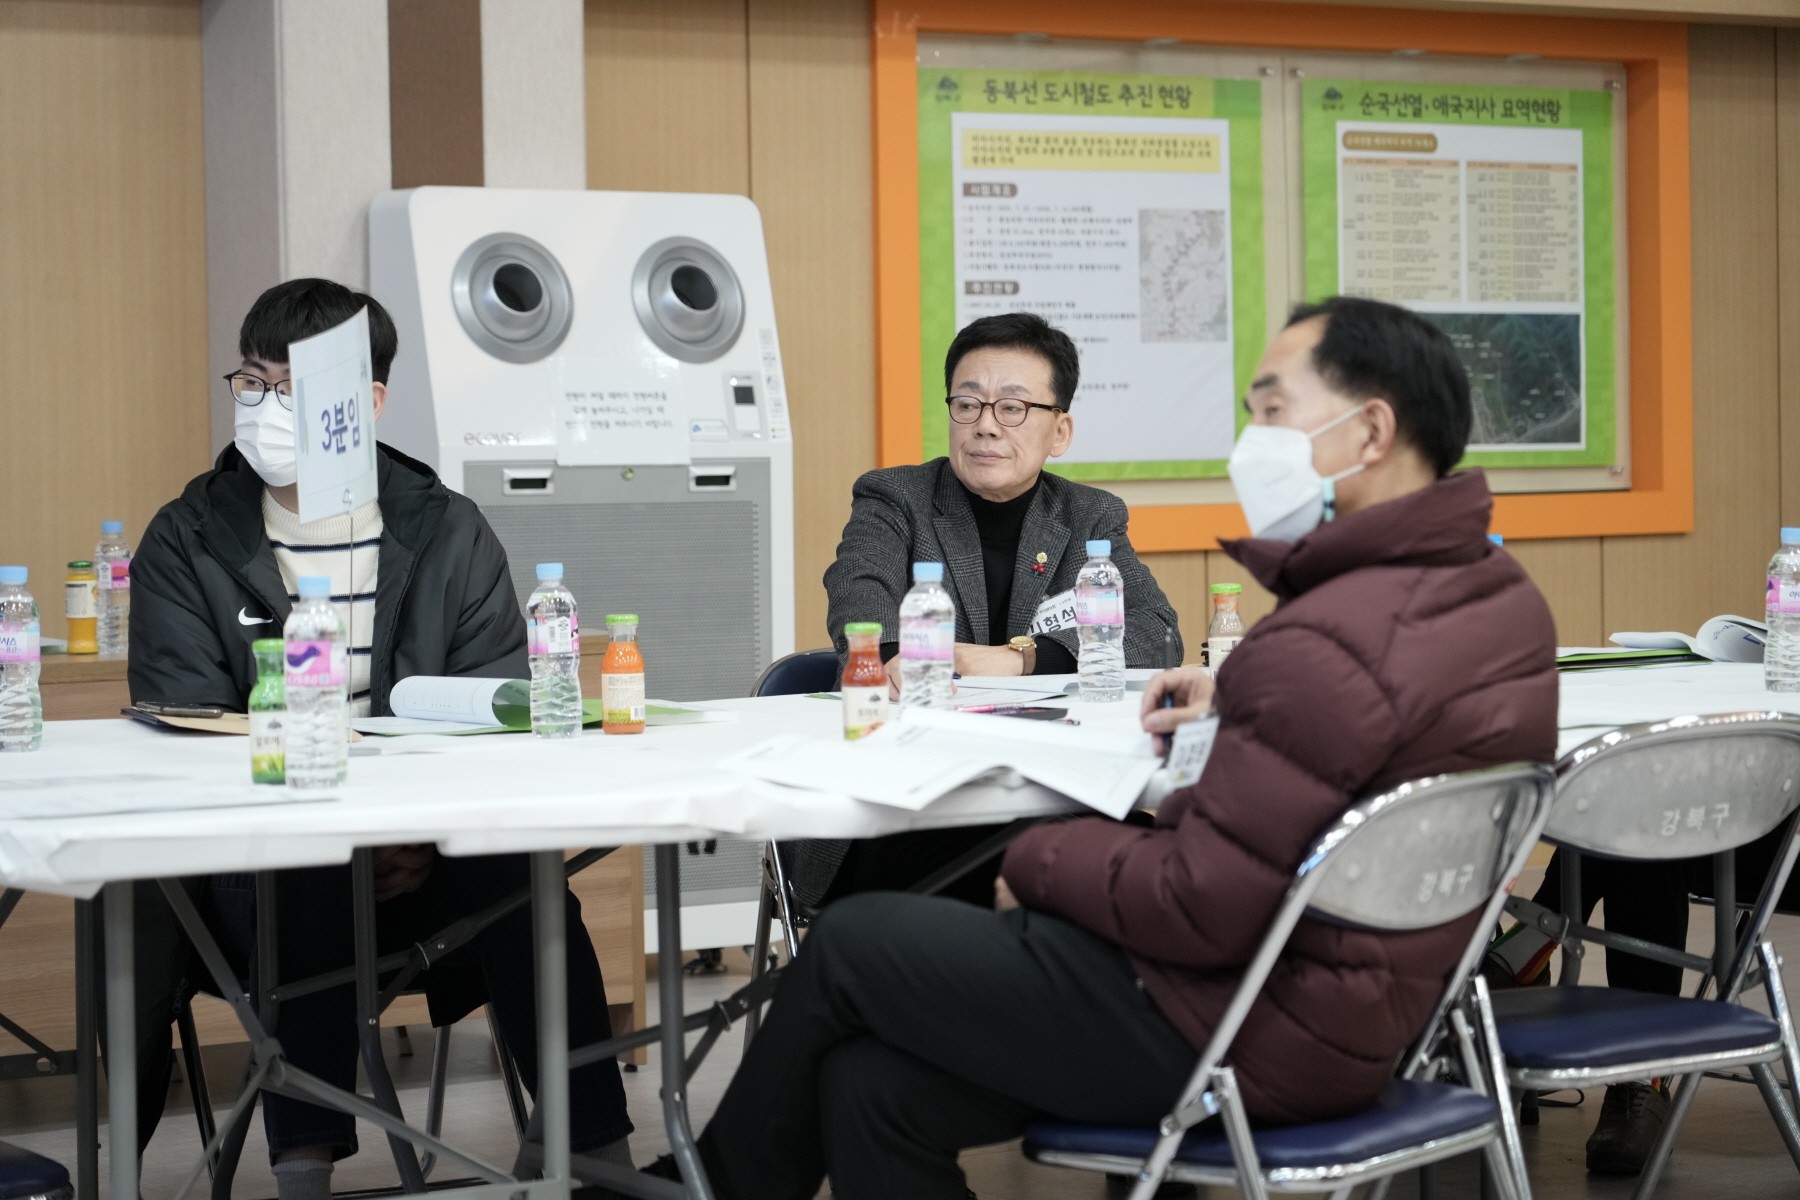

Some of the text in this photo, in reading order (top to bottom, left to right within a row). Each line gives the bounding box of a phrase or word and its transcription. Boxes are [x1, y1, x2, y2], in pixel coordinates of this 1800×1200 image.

[983, 78, 1193, 110] 동북선 도시철도 추진 현황
[1501, 96, 1562, 124] 묘역현황
[321, 391, 361, 456] 3분임
[1660, 803, 1731, 836] 강북구
[1420, 863, 1475, 904] 강북구
